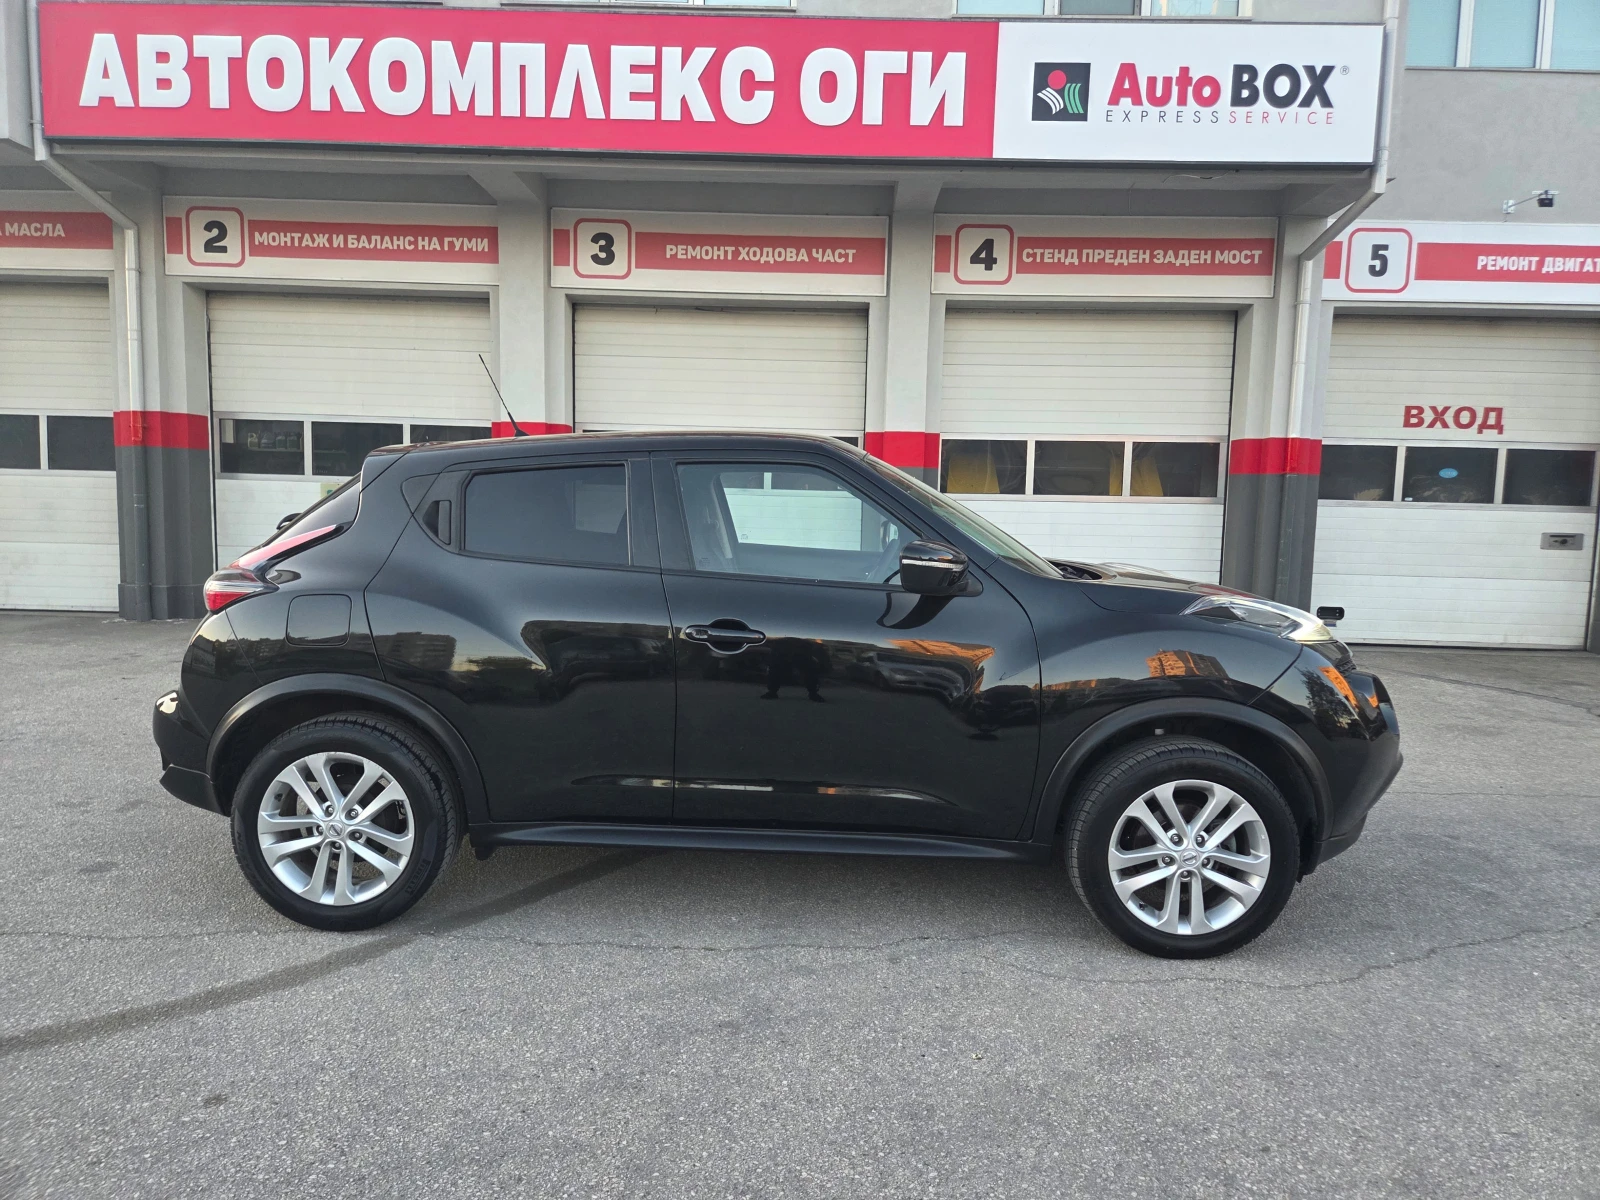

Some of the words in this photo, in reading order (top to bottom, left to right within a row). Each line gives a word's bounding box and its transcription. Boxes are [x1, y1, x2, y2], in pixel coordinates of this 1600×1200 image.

[79, 33, 774, 124] АВТОКОМПЛЕКС
[800, 48, 966, 126] ОГИ
[5, 223, 65, 237] МАСЛА
[203, 220, 228, 254] 2
[255, 232, 329, 247] МОНТАЖ
[333, 234, 344, 248] И
[348, 235, 414, 250] БАЛАНС
[418, 237, 441, 250] НА
[444, 238, 488, 251] ГУМИ
[590, 232, 616, 266] 3
[666, 245, 735, 260] РЕМОНТ
[738, 247, 809, 264] ХОДОВА
[812, 249, 856, 263] ЧАСТ
[969, 238, 998, 271] 4
[1023, 249, 1078, 265] СТЕНД
[1082, 249, 1149, 266] ПРЕДЕН
[1153, 250, 1211, 266] ЗАДЕН
[1215, 250, 1262, 264] МОСТ
[1369, 244, 1389, 277] 5
[1477, 256, 1539, 270] РЕМОНТ
[1403, 406, 1504, 434] ВХОД
